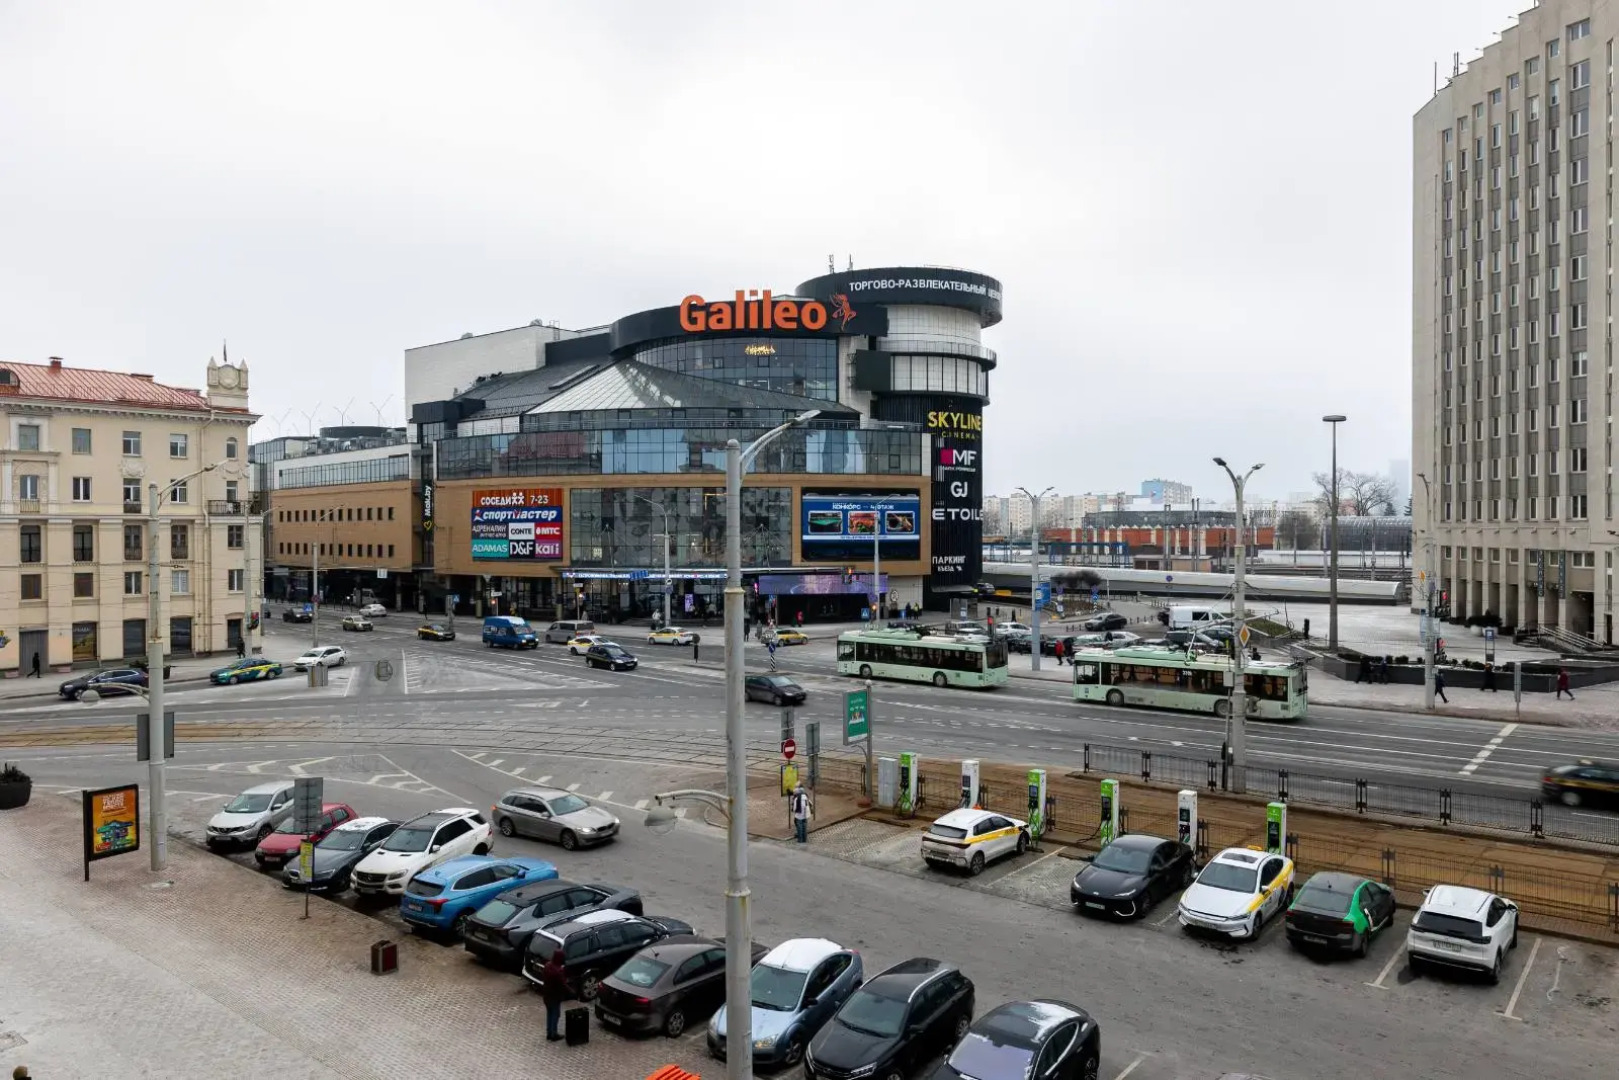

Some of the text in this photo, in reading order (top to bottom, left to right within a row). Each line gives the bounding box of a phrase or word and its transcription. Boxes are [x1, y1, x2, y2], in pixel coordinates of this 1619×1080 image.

[849, 279, 986, 296] ТОРГОВО-РАЗВЛЕКАТЕЛЬНЫЙ
[679, 290, 827, 332] Galileo
[928, 411, 981, 431] SKYLINE
[941, 431, 976, 440] CINEMA
[953, 449, 977, 466] MF
[950, 481, 968, 498] GJ
[530, 495, 549, 505] 7-23
[932, 508, 983, 520] ETOILE
[472, 544, 508, 552] ADAMAS
[509, 541, 534, 555] D&F
[535, 543, 560, 555] kari
[932, 555, 966, 565] ПАРКИНГ
